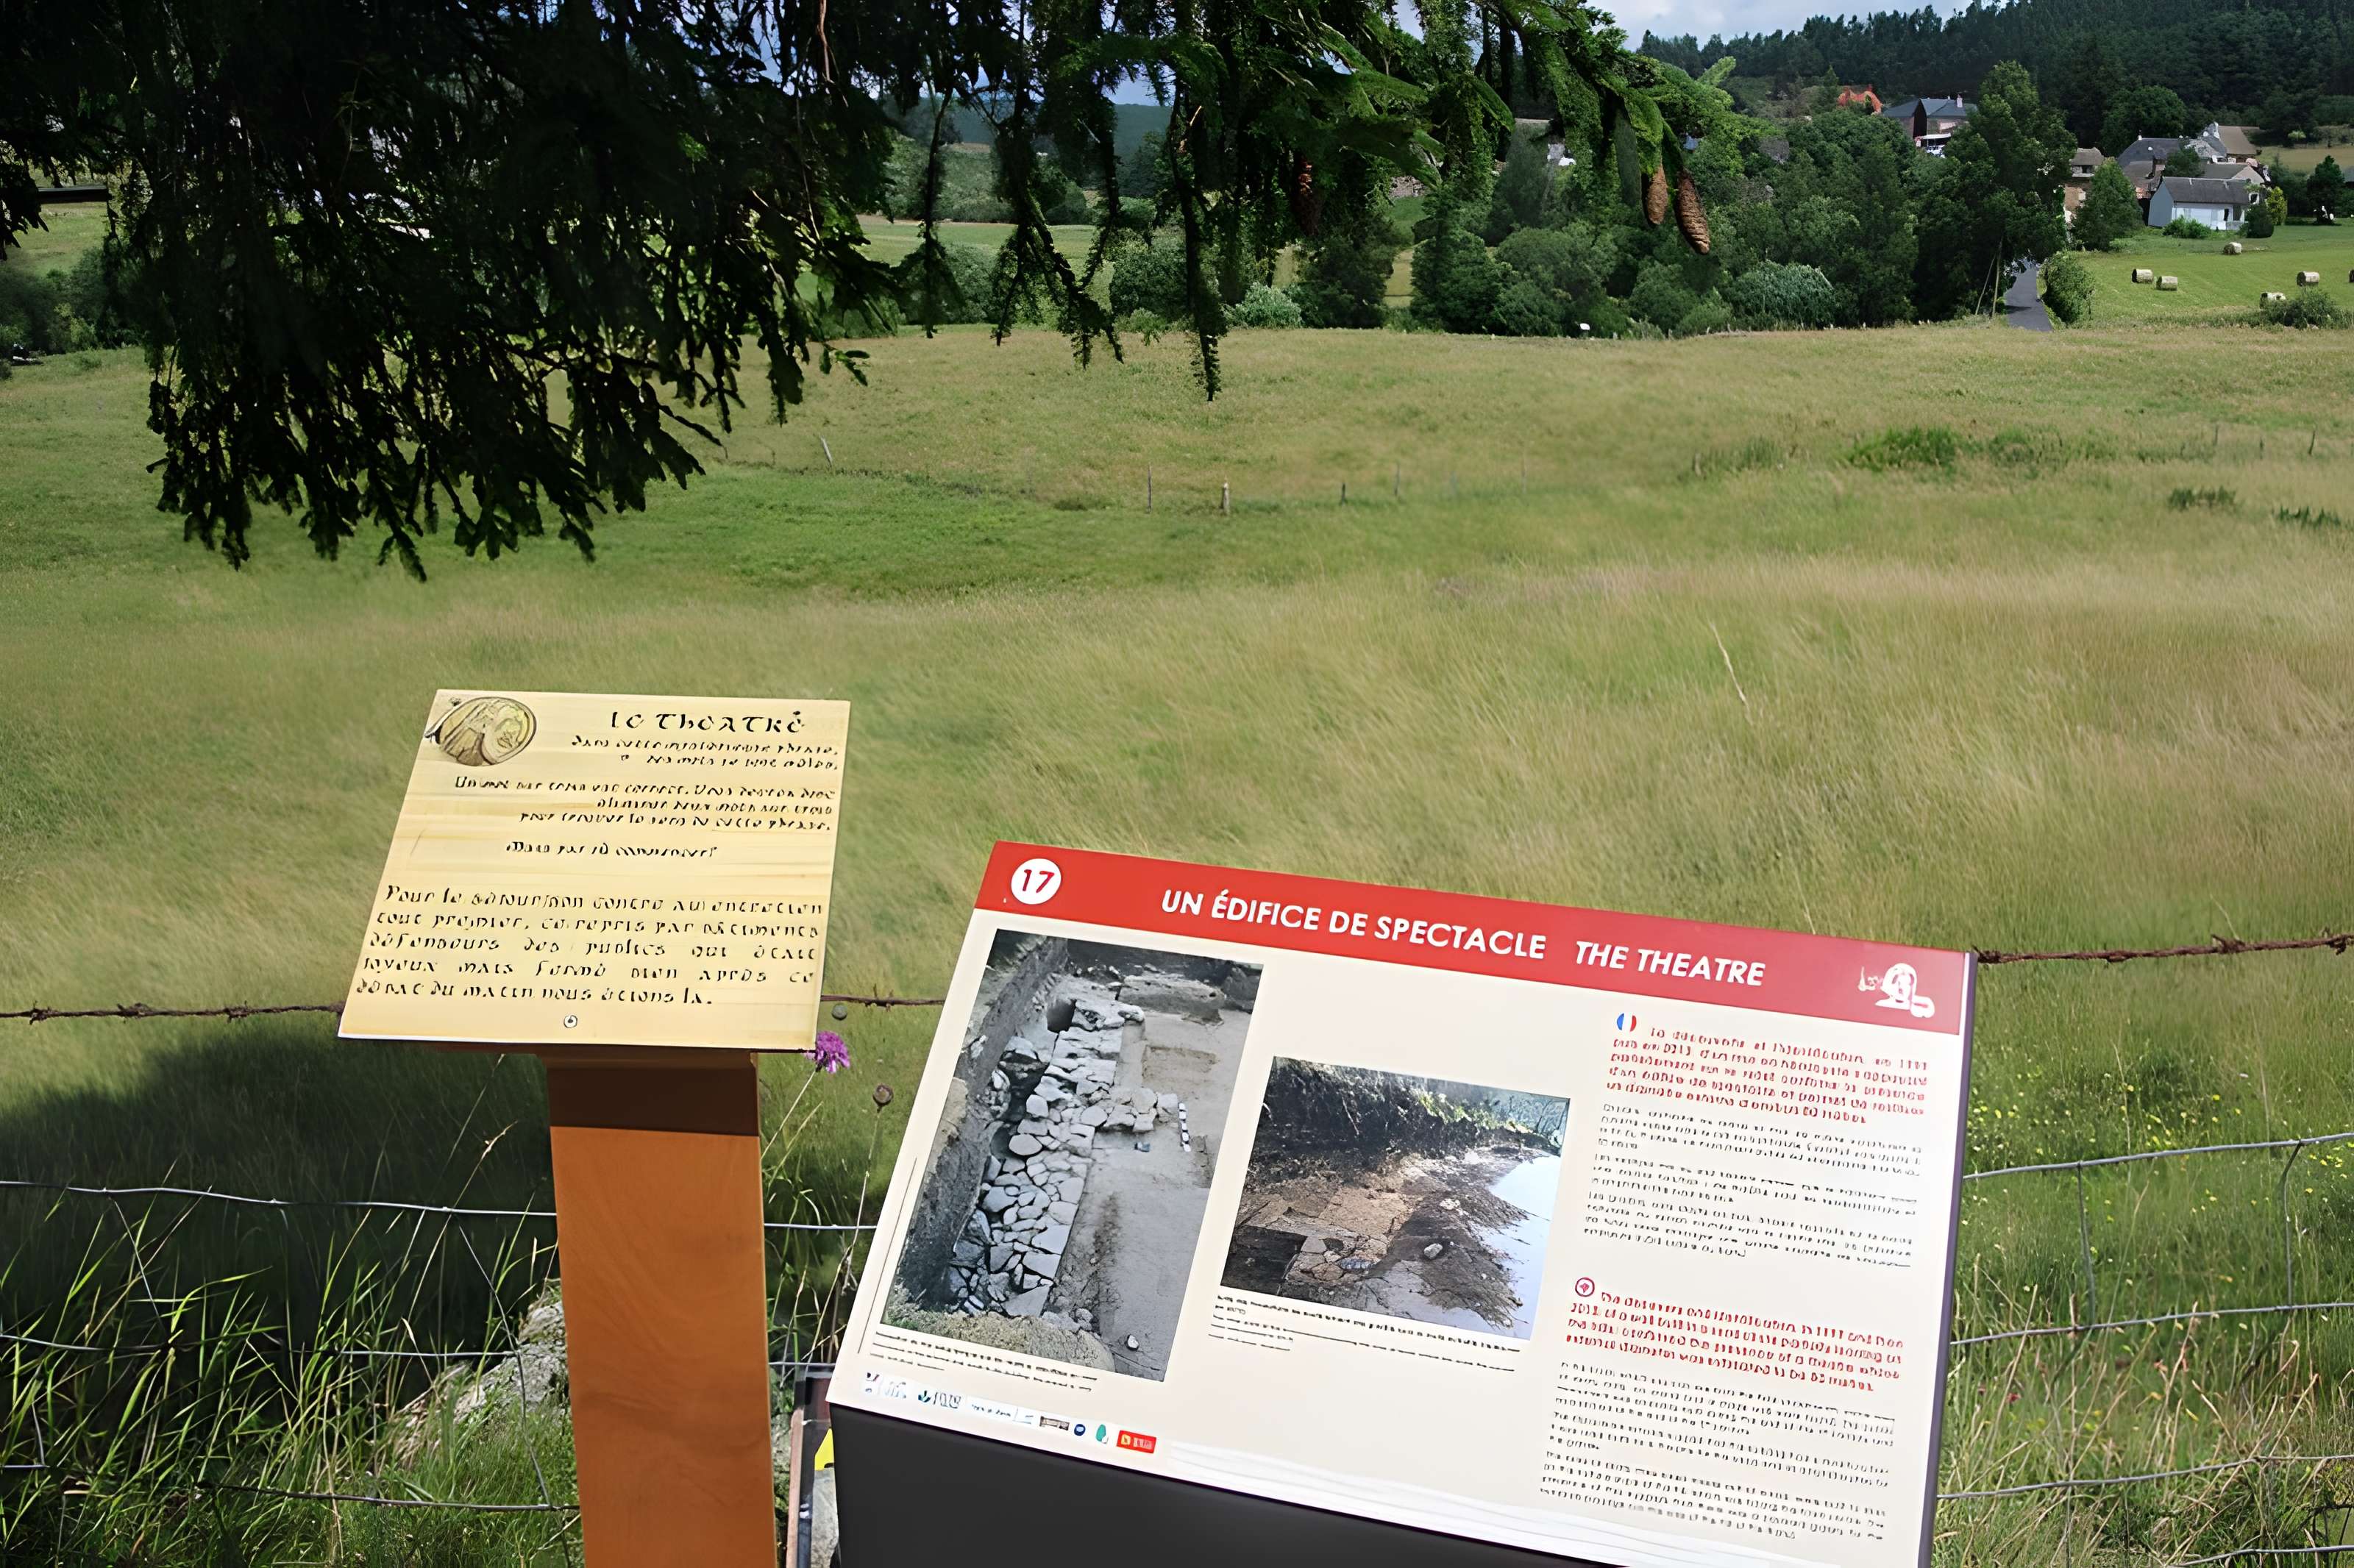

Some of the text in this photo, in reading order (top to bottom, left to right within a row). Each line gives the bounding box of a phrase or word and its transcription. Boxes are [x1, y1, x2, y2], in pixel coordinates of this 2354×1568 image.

[1021, 869, 1056, 894] 17
[1161, 888, 1767, 988] UN ÉDIFICE DE SPECTACLE THE THEATRE
